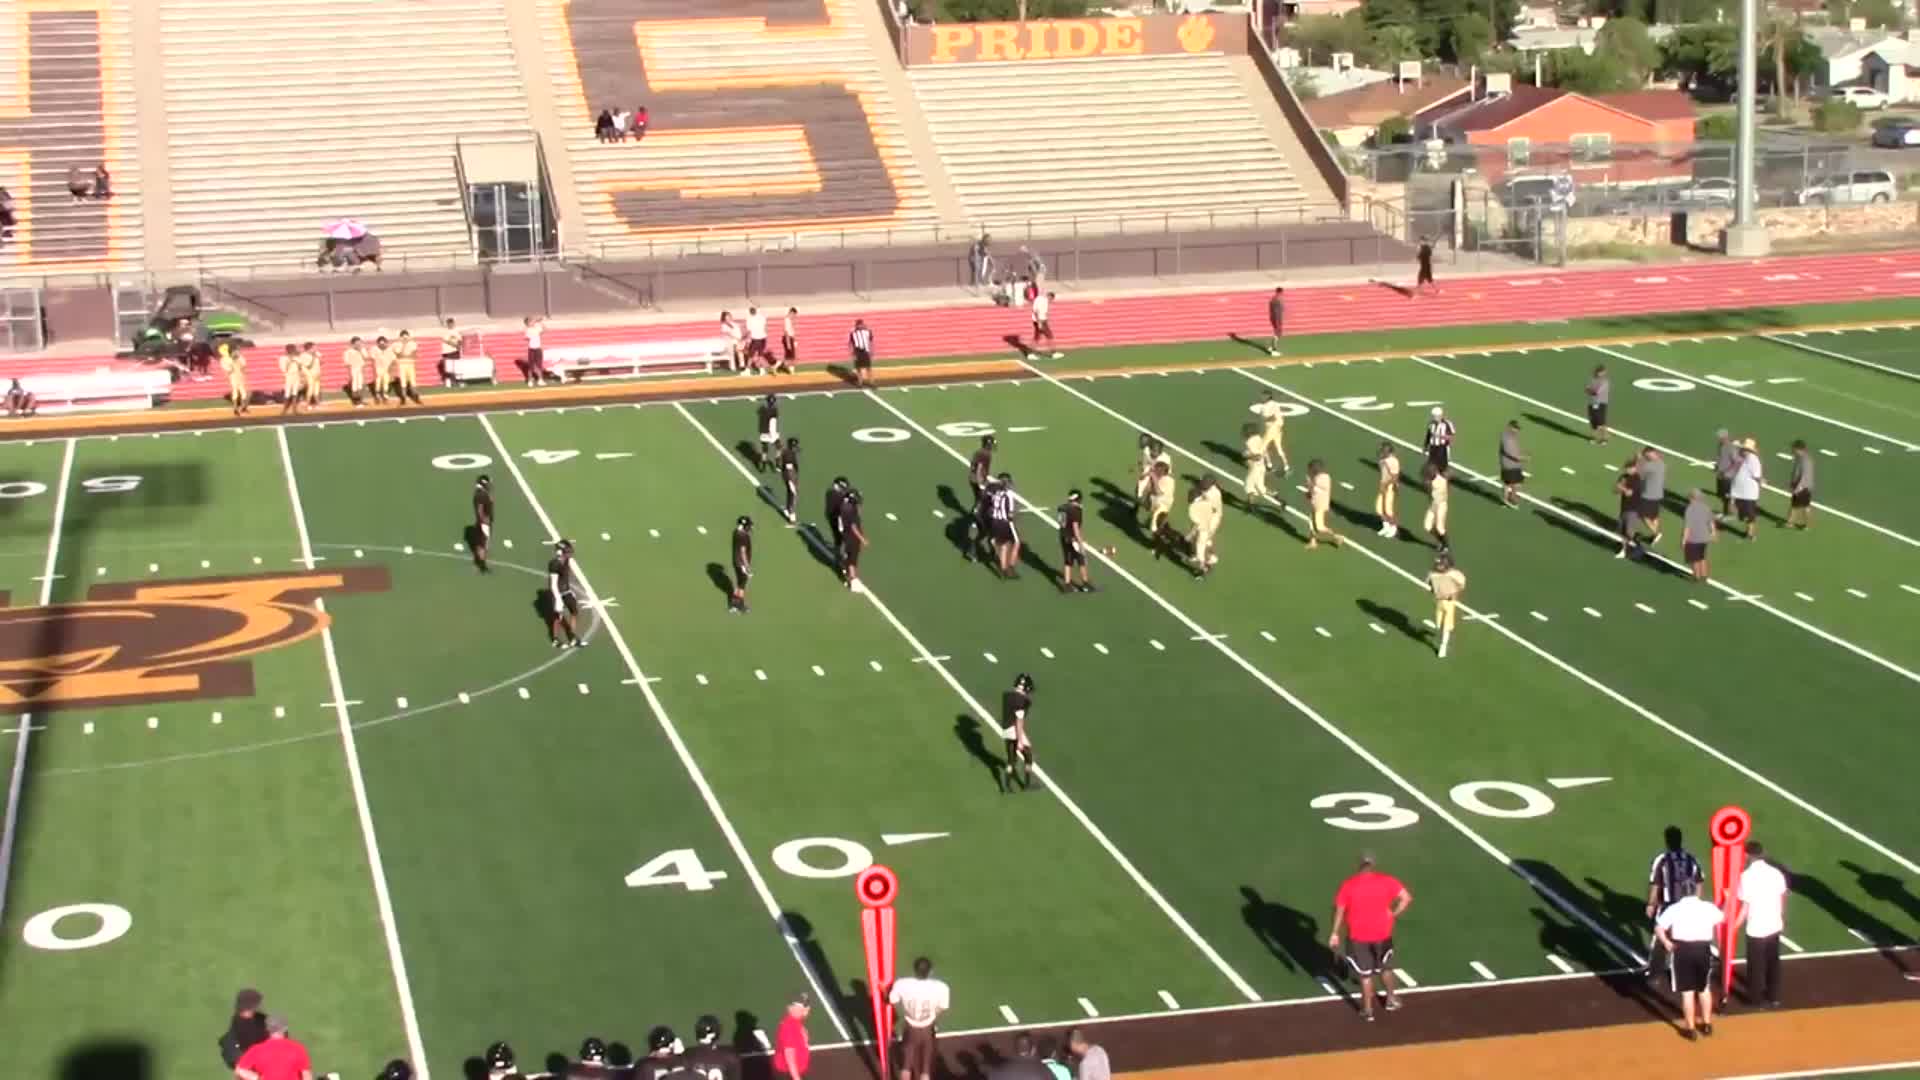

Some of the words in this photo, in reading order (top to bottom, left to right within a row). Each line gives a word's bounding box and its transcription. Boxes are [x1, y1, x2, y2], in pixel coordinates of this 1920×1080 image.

[930, 18, 1144, 62] PRIDE
[1310, 780, 1555, 831] 30
[625, 837, 873, 891] 40
